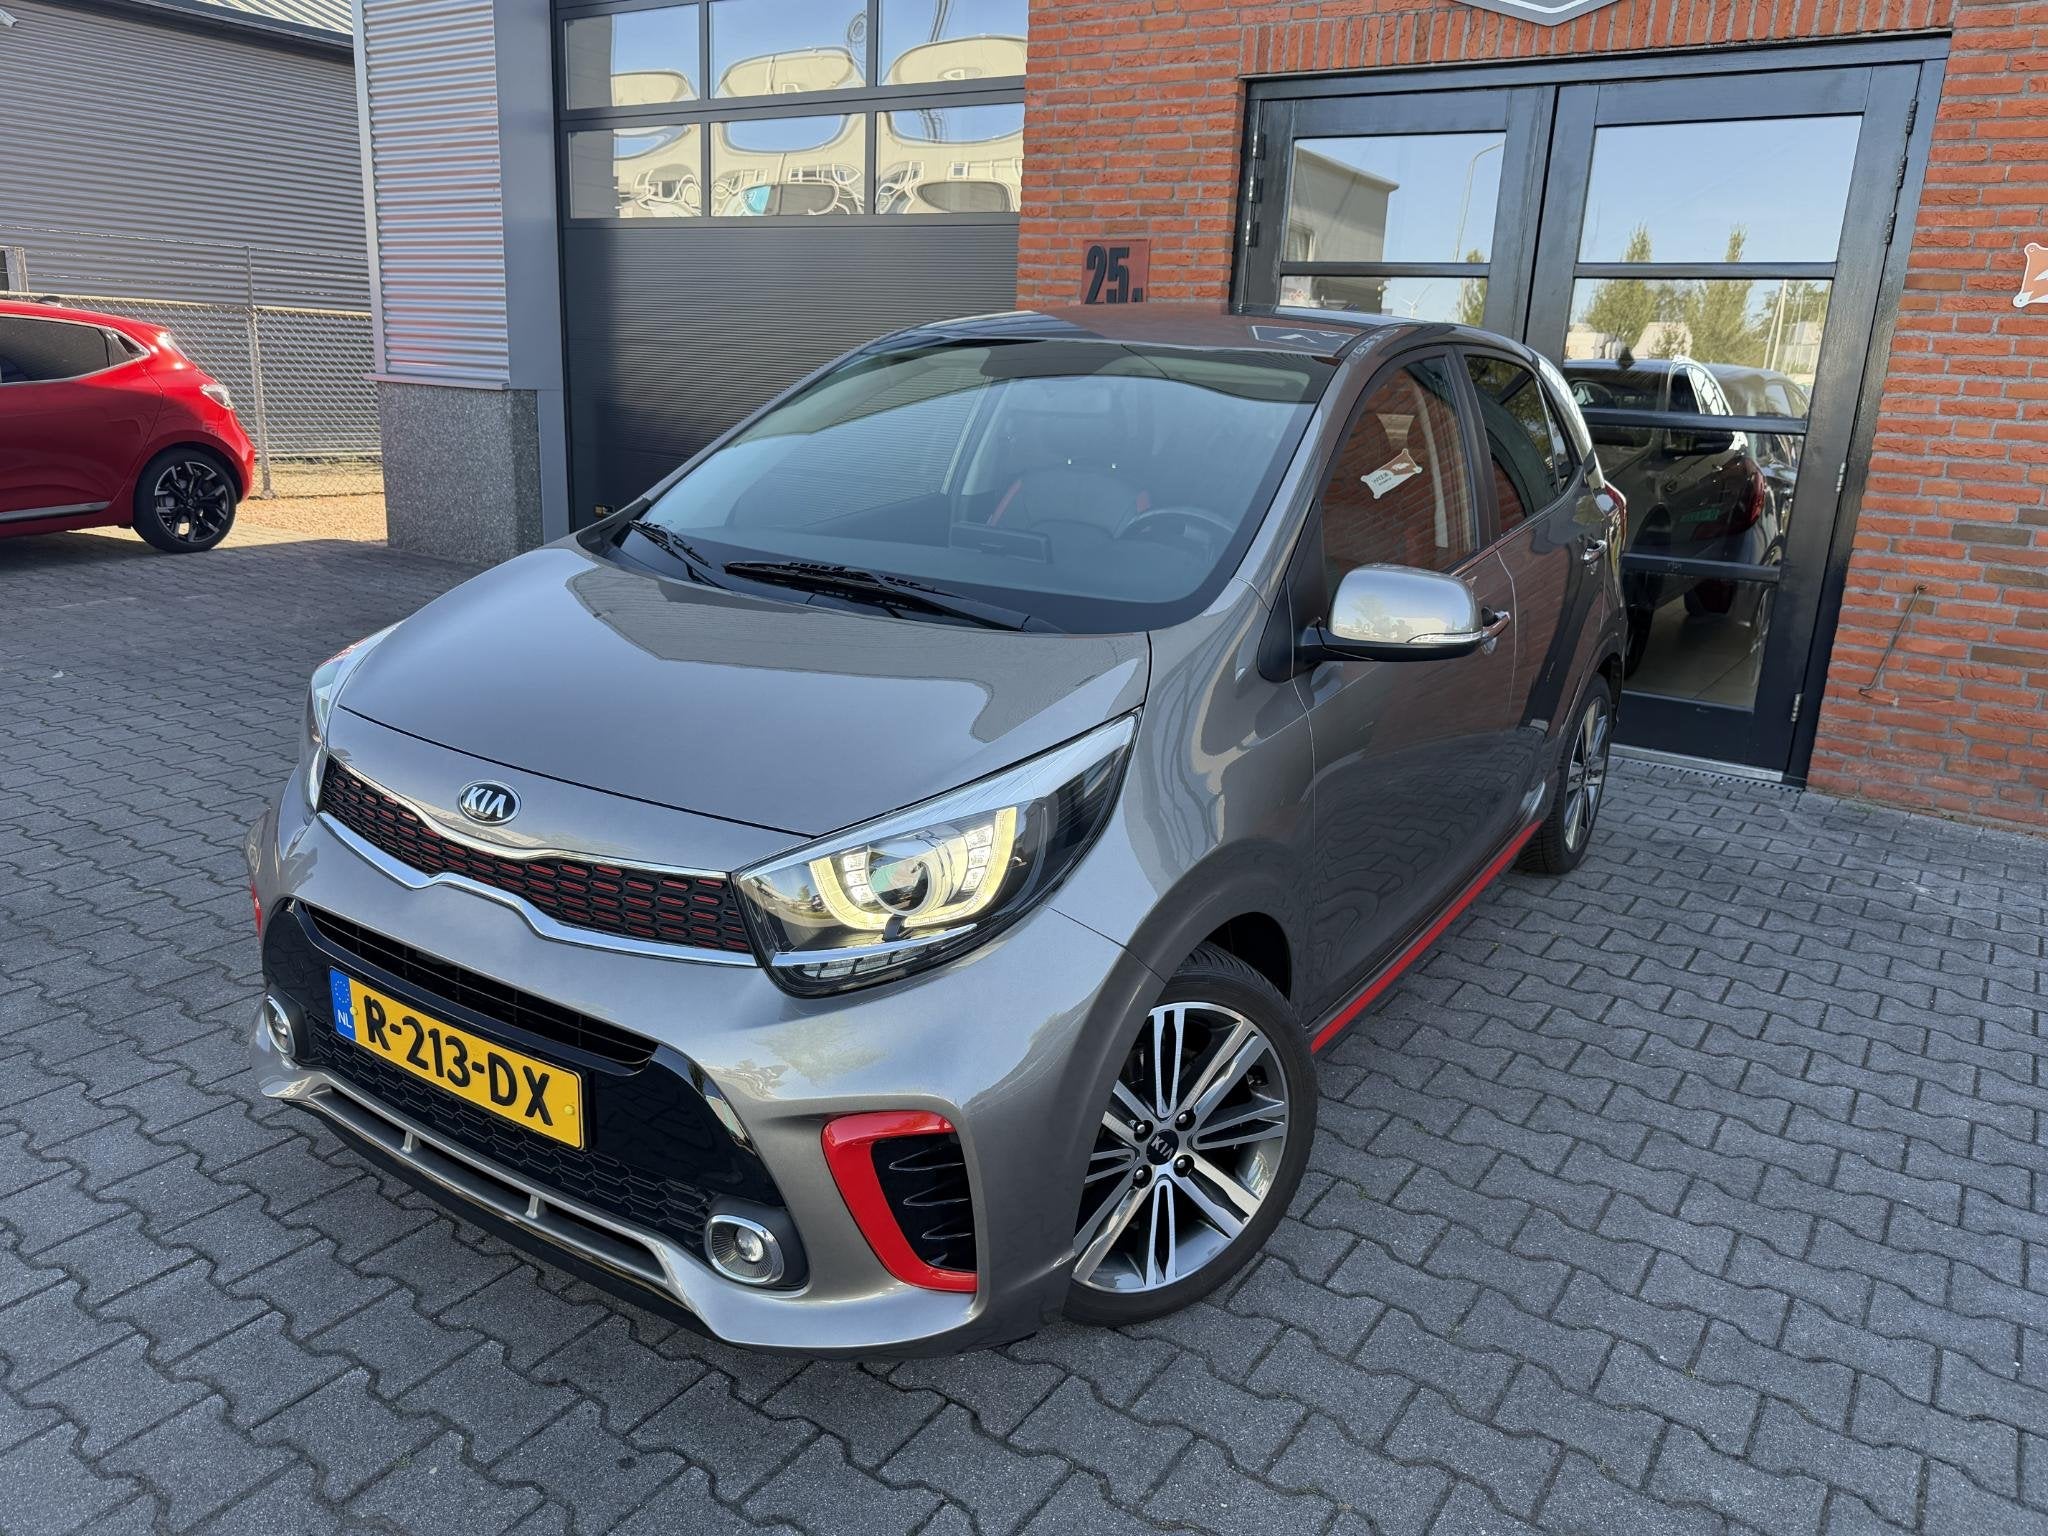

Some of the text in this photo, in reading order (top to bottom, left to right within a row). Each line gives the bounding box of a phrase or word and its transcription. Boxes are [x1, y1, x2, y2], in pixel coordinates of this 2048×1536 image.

[463, 786, 507, 818] KIA
[337, 1009, 353, 1029] NL
[364, 995, 554, 1127] R-213-DX
[1150, 1136, 1174, 1160] KIA
